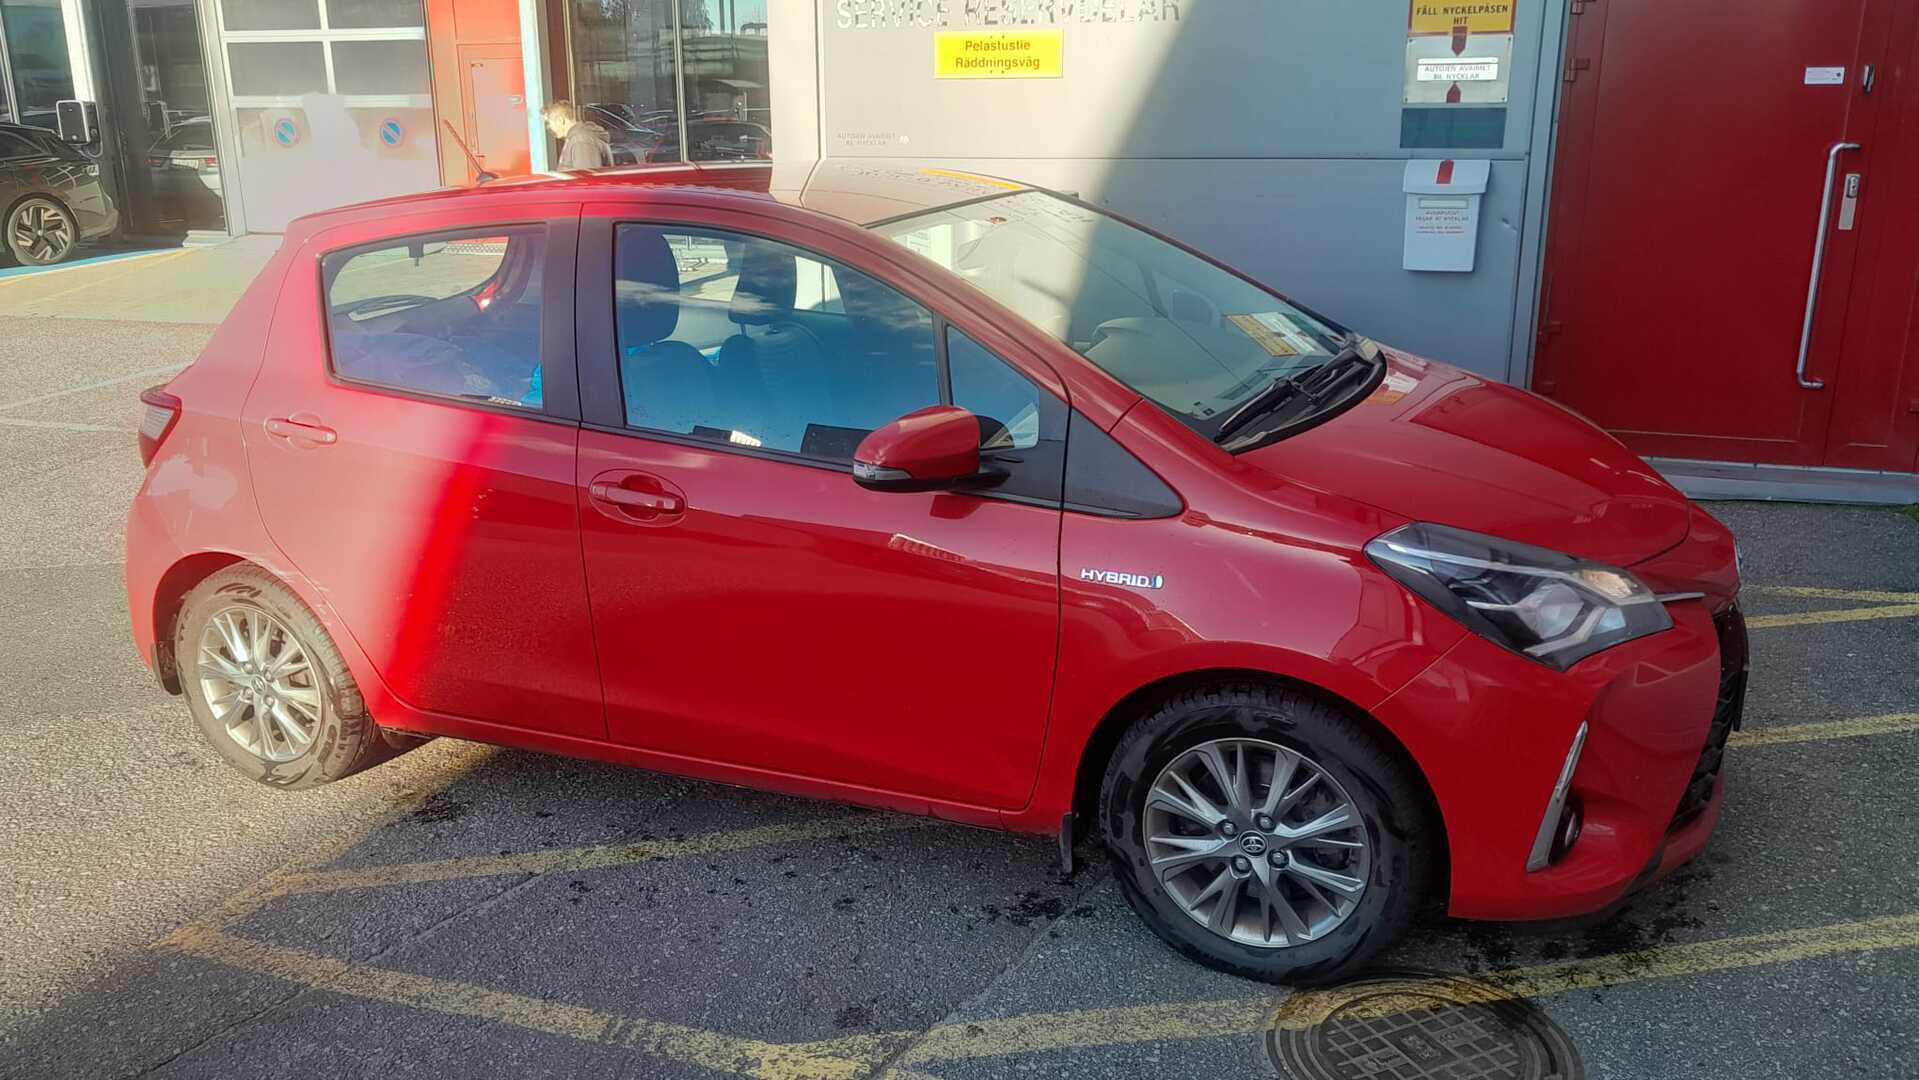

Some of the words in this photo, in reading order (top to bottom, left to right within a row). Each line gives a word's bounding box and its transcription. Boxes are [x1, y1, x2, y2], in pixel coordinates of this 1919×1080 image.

[837, 0, 950, 29] SERVICE
[1453, 16, 1468, 25] HIT
[964, 39, 1031, 51] Pelastustie
[955, 55, 1041, 70] Räddningsväg
[1080, 568, 1150, 588] HYBRID
